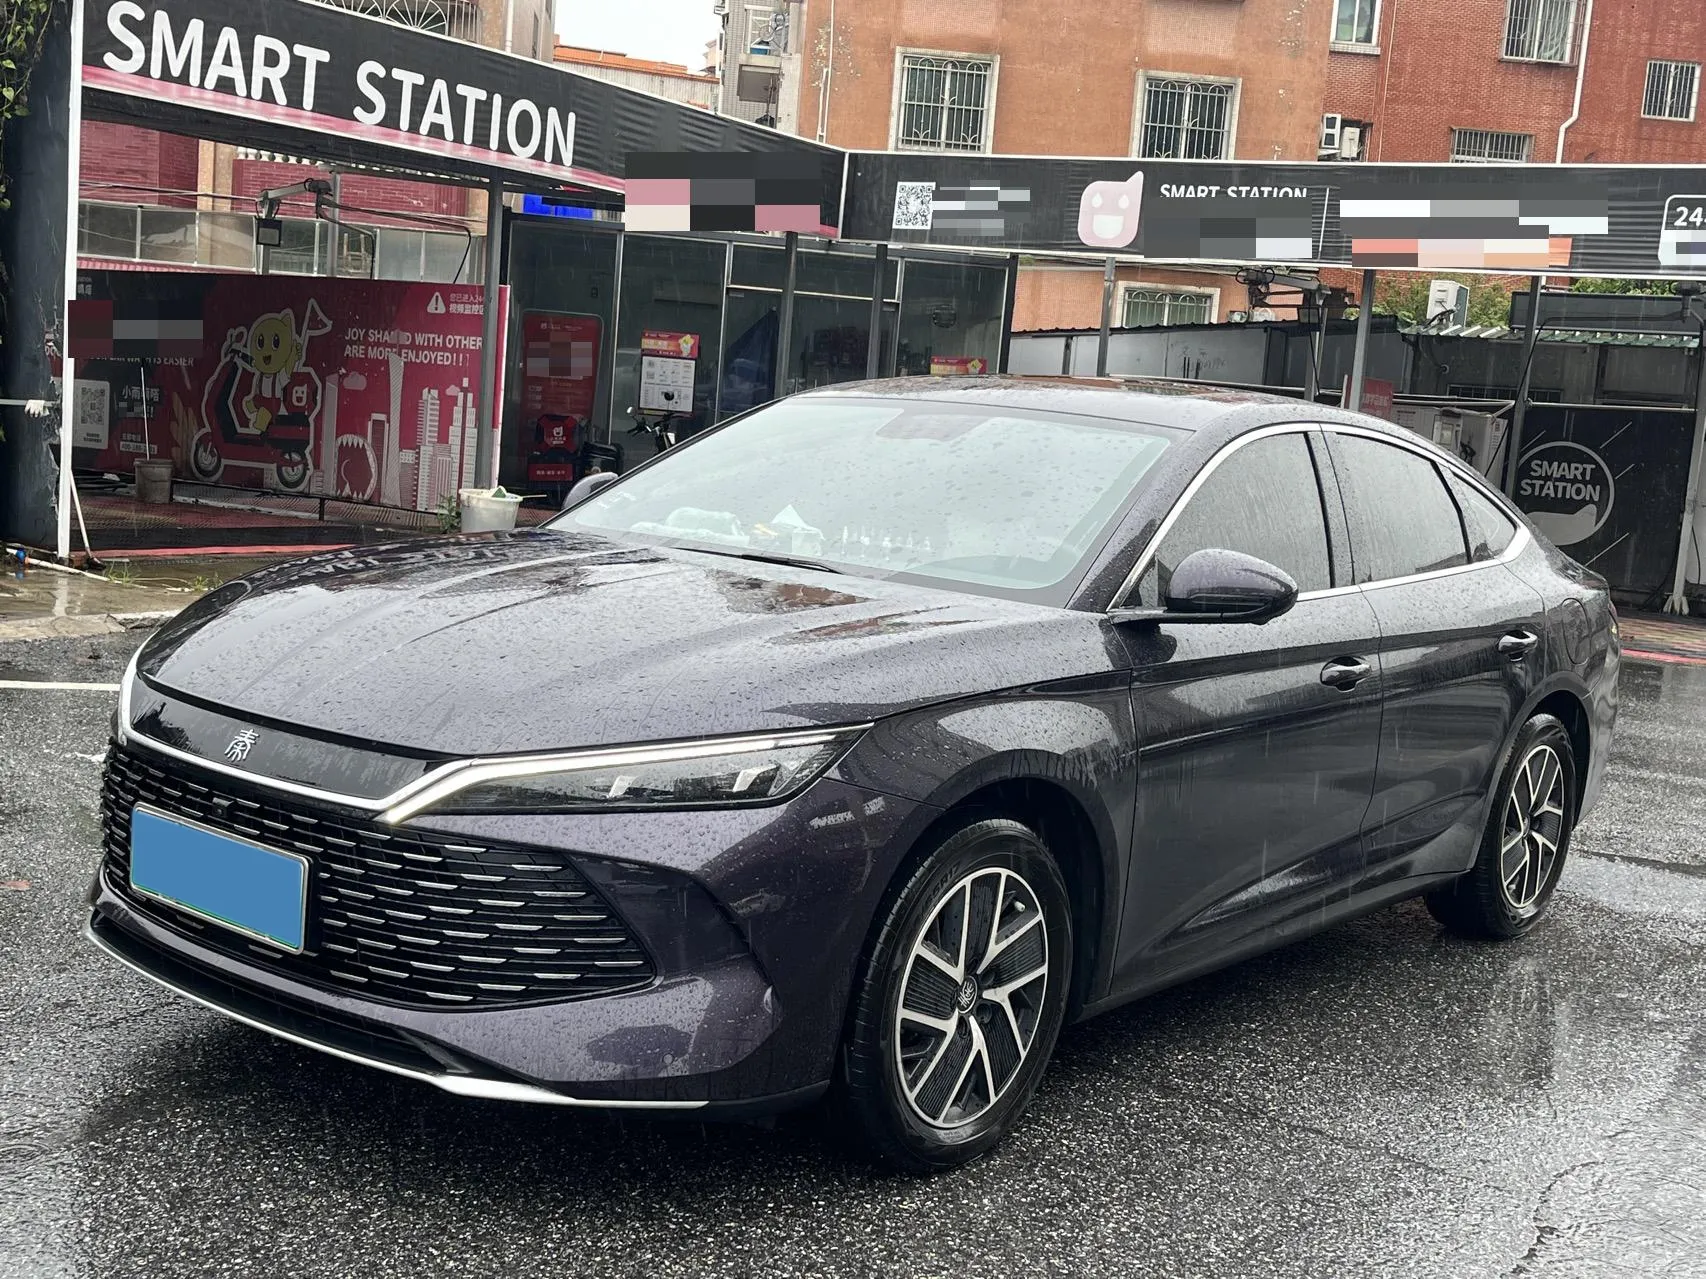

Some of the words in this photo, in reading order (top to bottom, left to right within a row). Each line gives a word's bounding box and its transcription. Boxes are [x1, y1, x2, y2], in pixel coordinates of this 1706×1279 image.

[103, 1, 330, 111] SMART
[353, 60, 576, 167] STATION
[1160, 183, 1220, 198] SMART
[1227, 185, 1307, 198] STATION
[1674, 206, 1706, 227] 24
[345, 328, 366, 341] JOY
[368, 329, 412, 345] SHAD
[415, 333, 443, 347] WITH
[344, 344, 365, 358] ARE
[1530, 459, 1596, 481] SMART
[1519, 478, 1601, 502] STATION
